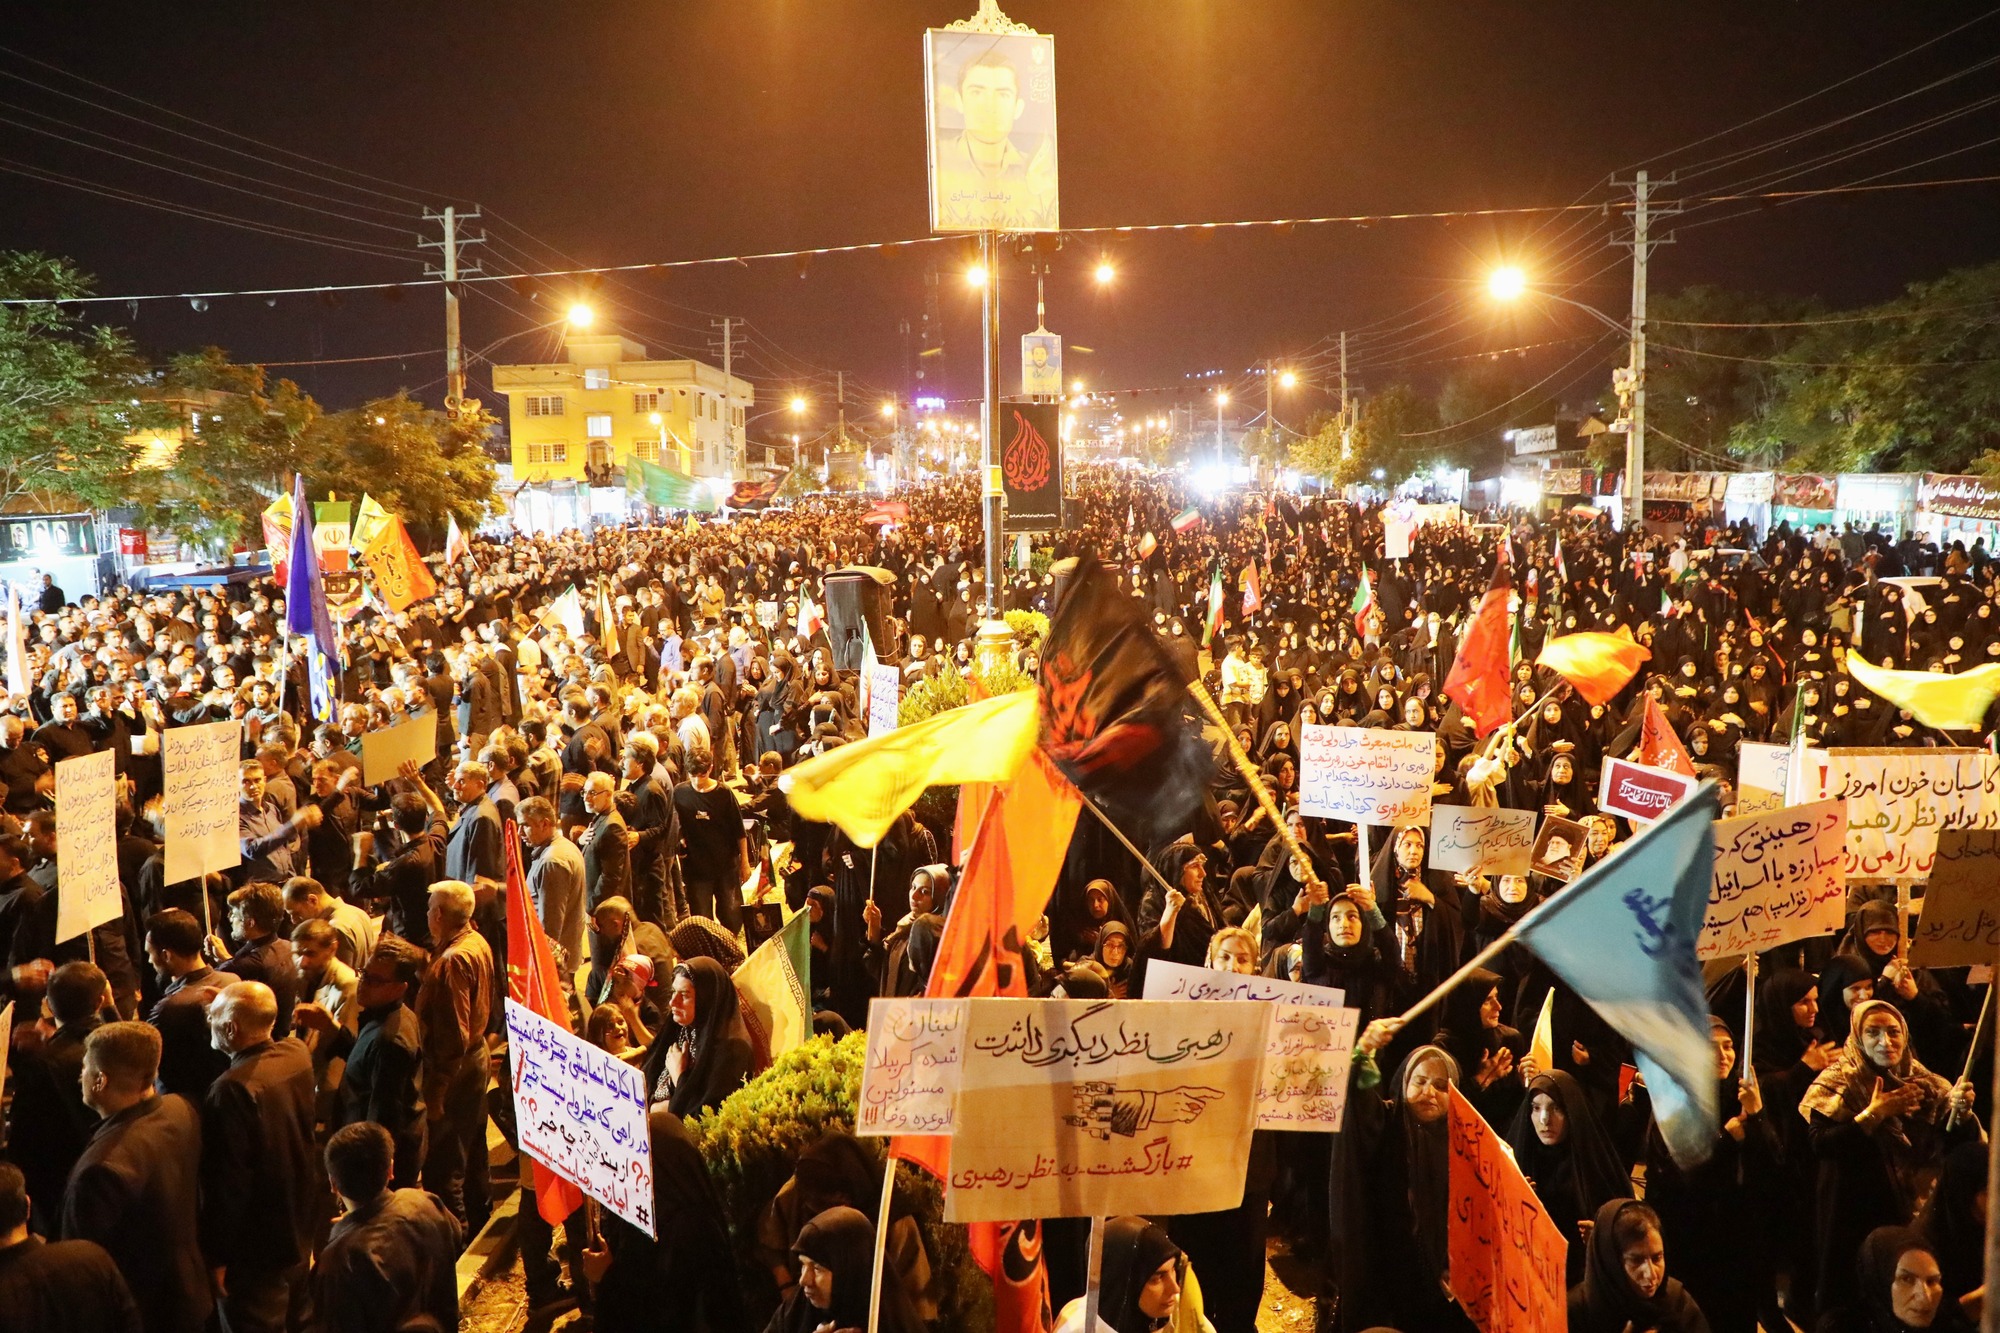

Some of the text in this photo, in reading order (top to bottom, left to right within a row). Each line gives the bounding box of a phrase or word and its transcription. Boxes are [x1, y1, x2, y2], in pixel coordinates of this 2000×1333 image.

[1304, 730, 1324, 745] فقیه
[1414, 740, 1432, 754] این
[1345, 756, 1366, 769] خون
[1308, 770, 1323, 782] از
[1346, 790, 1376, 814] کوتاه
[1377, 803, 1402, 821] رهبری
[1402, 798, 1428, 818] شروط
[1900, 798, 1937, 836] نظر
[1728, 822, 1759, 857] که
[1773, 857, 1784, 888] با
[1789, 845, 1840, 884] مبارزه
[1741, 905, 1764, 933] هم
[1171, 979, 1186, 994] از
[893, 1002, 960, 1042] لبنان
[1276, 1005, 1300, 1023] شما
[1304, 1015, 1337, 1032] یعنی
[1106, 1020, 1150, 1057] نظر
[1147, 1028, 1234, 1064] رهبری
[1266, 1042, 1276, 1053] و
[1320, 1035, 1347, 1052] ملت
[922, 1047, 957, 1068] شده
[597, 1106, 614, 1131] که
